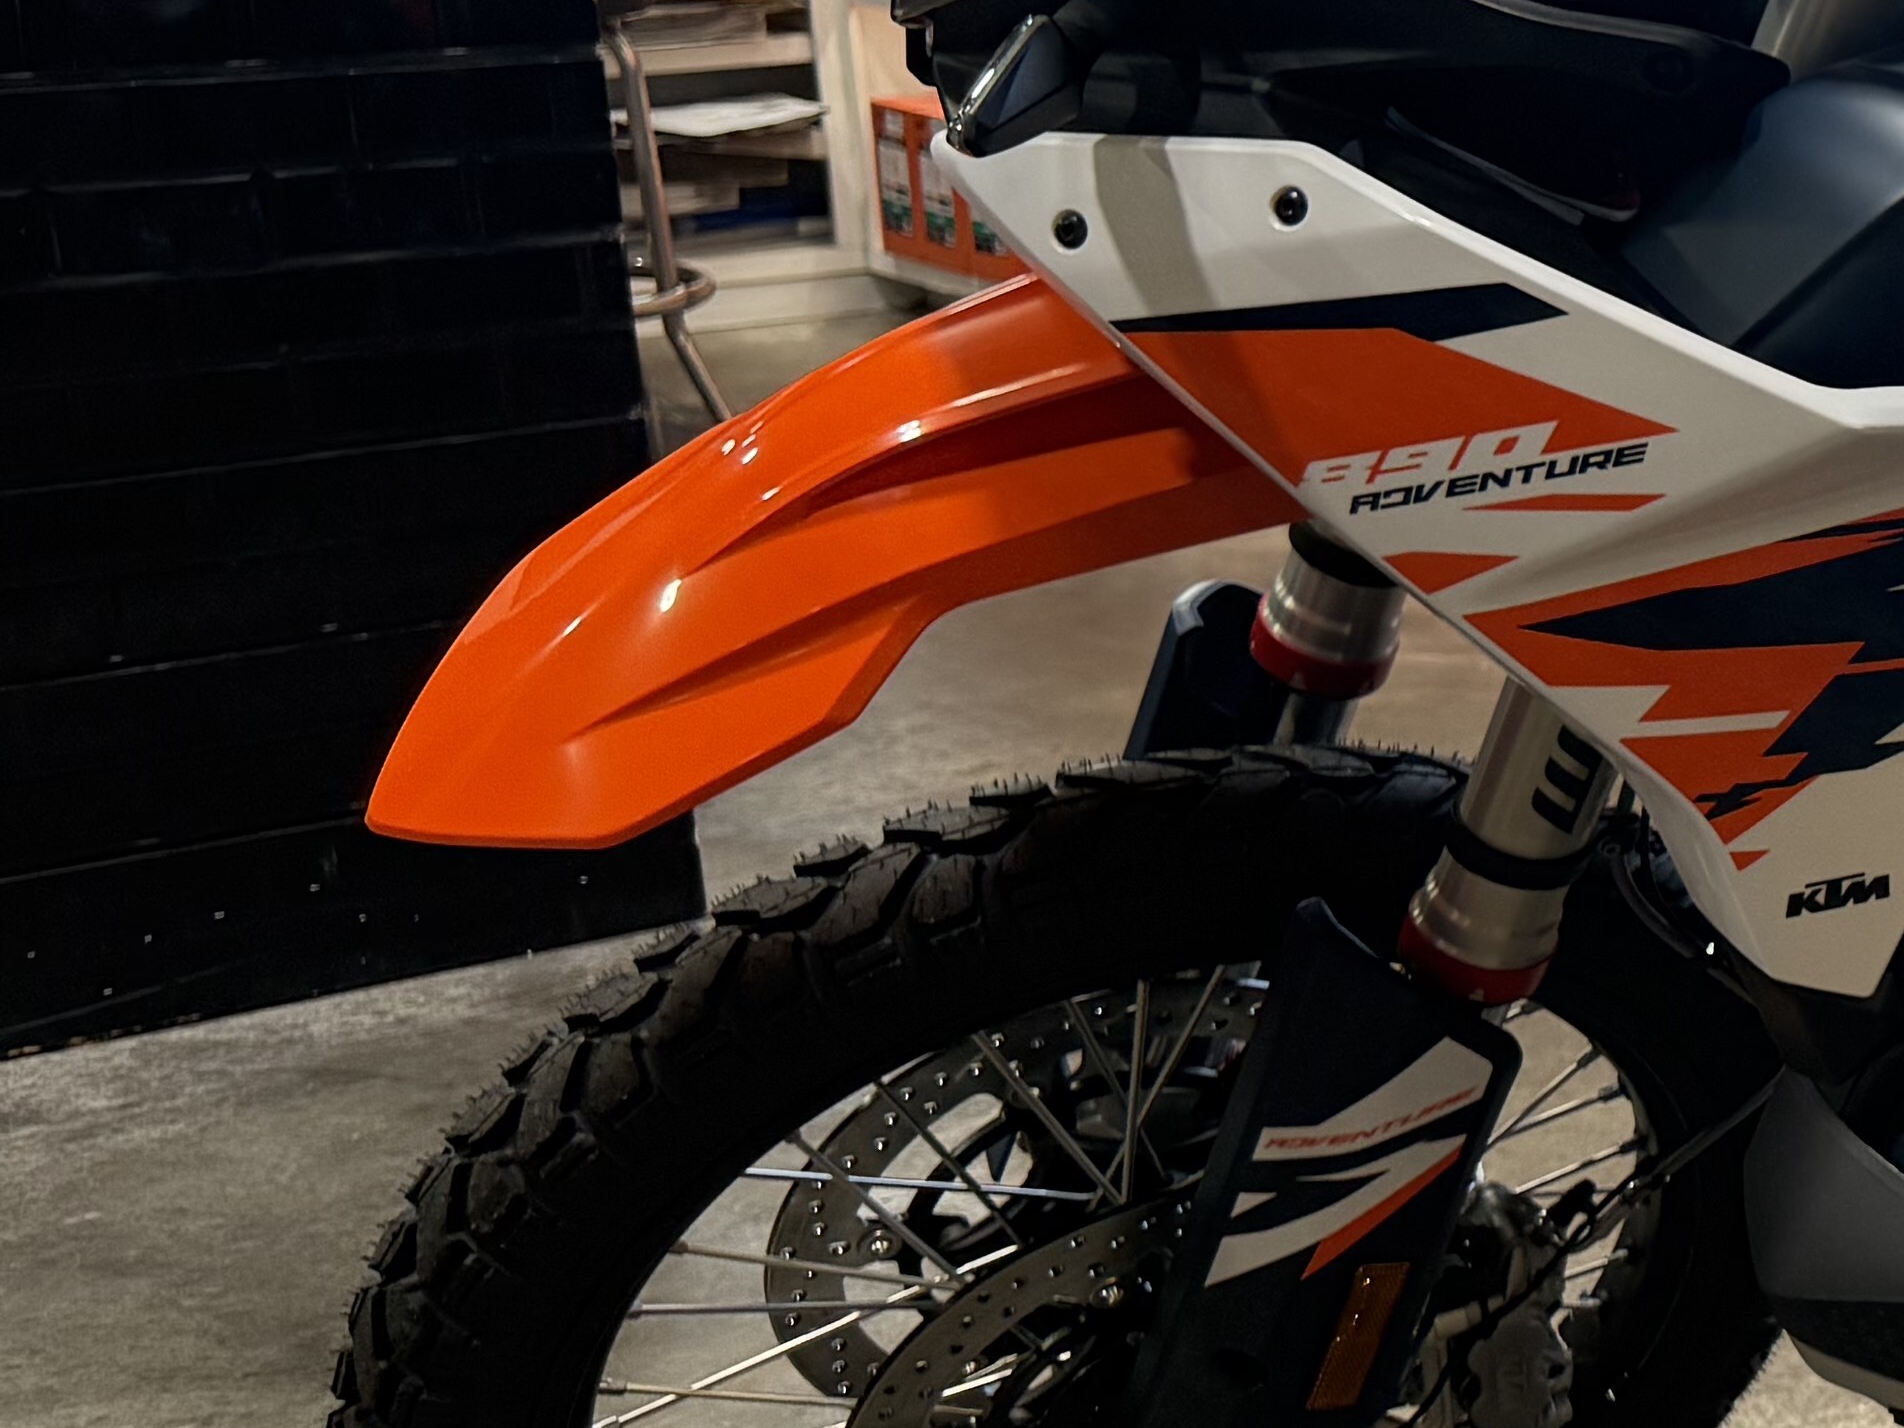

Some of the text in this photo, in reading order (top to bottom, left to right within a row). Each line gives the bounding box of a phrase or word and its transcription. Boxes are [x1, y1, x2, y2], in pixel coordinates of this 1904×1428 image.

[1300, 420, 1558, 487] 890
[1348, 442, 1649, 515] ADVENTURE
[1785, 872, 1890, 919] KTM
